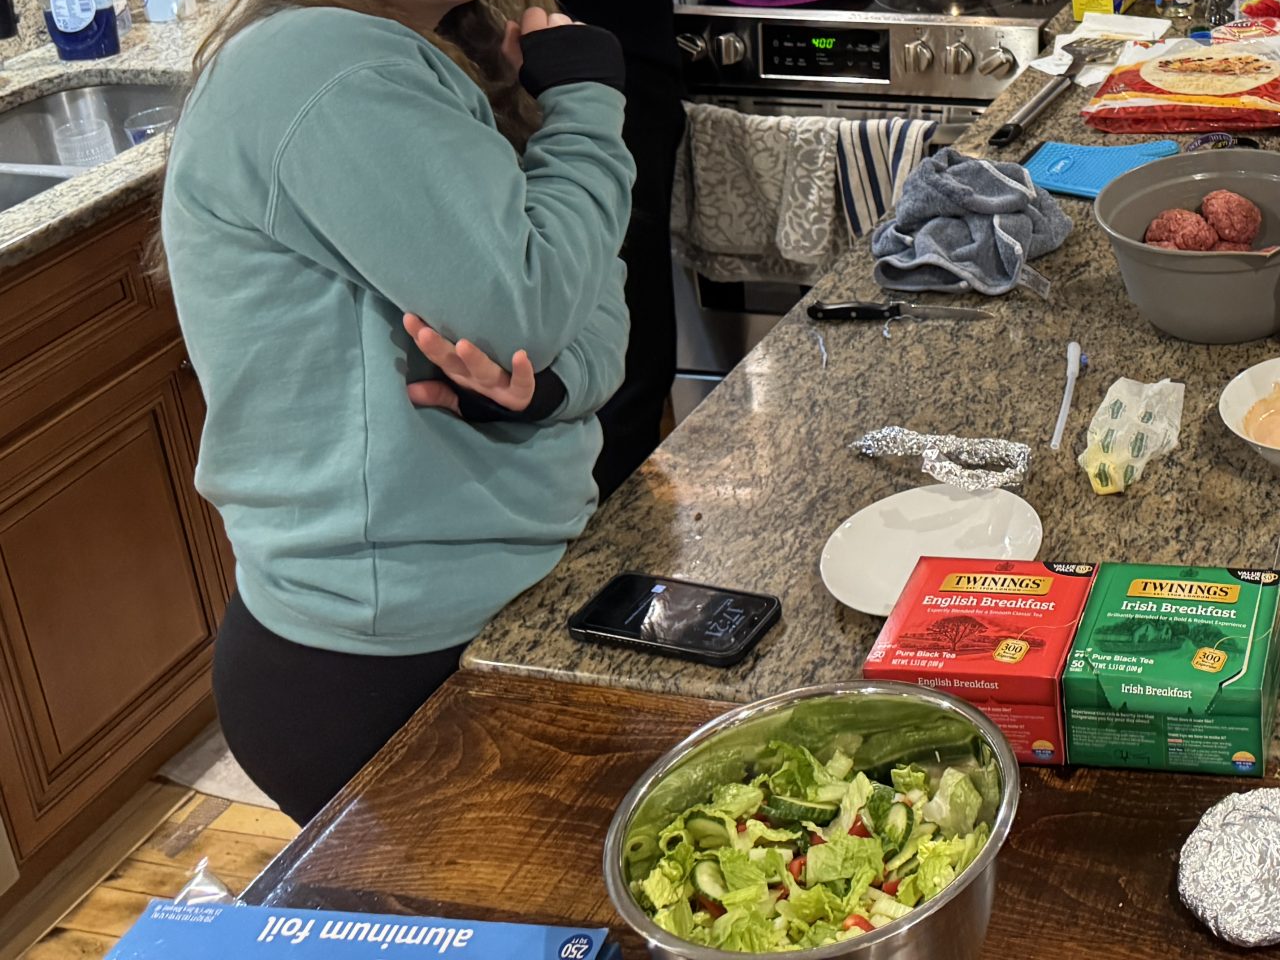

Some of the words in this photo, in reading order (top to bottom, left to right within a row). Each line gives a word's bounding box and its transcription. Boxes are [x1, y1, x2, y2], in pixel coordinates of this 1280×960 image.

[955, 576, 1043, 589] TWININGS
[1141, 581, 1229, 597] TWININGS
[923, 596, 977, 608] English
[980, 598, 1056, 610] Breakfast
[1121, 601, 1157, 612] Irish
[1161, 604, 1236, 618] Breakfast
[1002, 643, 1023, 653] 300
[1200, 652, 1220, 663] 300
[918, 678, 952, 687] English
[954, 679, 999, 689] Breakfast
[1121, 684, 1144, 694] Irish
[1145, 686, 1192, 698] Breakfast
[256, 916, 314, 944] foil
[319, 920, 474, 953] aluminum
[561, 943, 589, 959] 250
